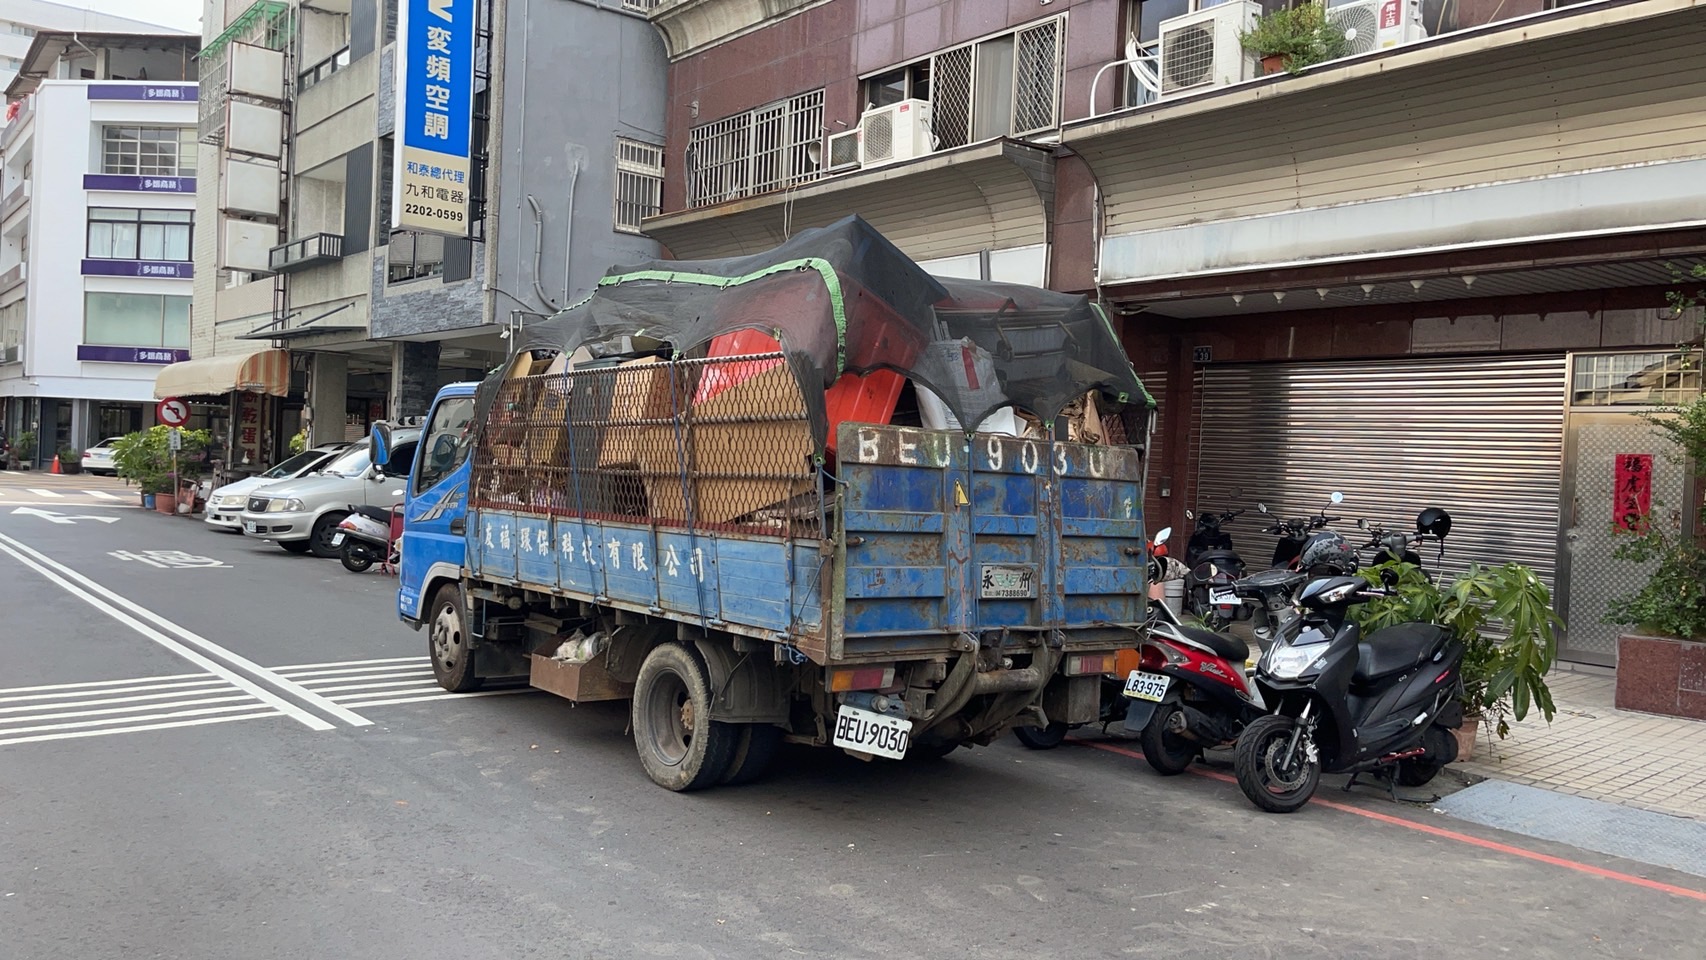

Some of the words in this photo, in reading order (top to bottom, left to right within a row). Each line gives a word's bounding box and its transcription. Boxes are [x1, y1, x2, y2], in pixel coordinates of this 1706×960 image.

[407, 161, 465, 184] 和泰總代理
[405, 183, 464, 204] 九和電器
[405, 203, 463, 222] 2202-0599
[106, 550, 234, 569] 慢
[1125, 678, 1166, 698] L83-975
[836, 715, 908, 753] BEU-9030
